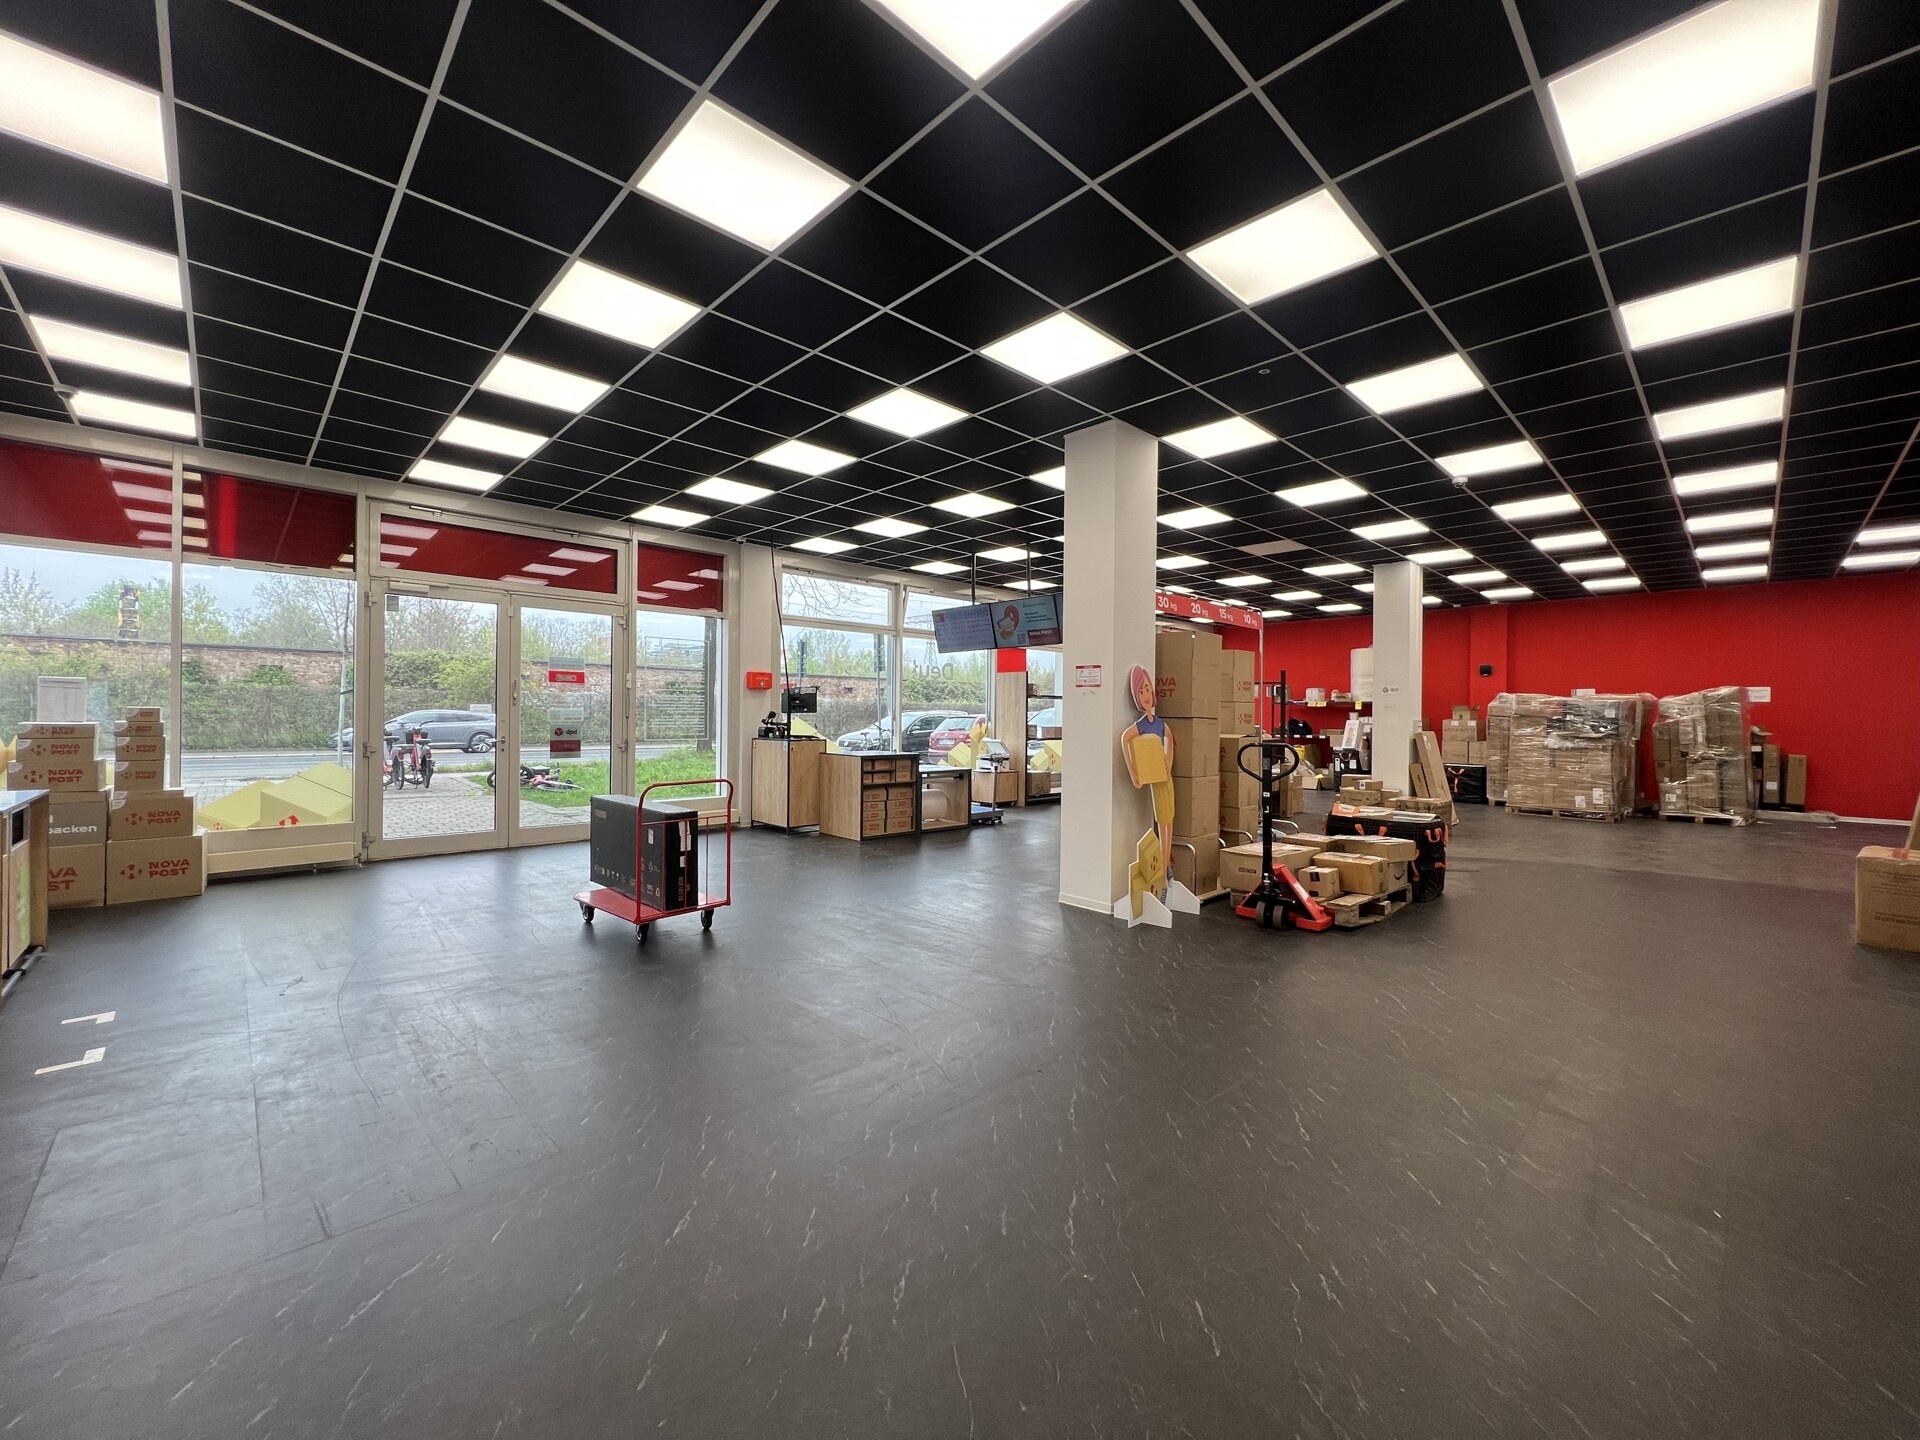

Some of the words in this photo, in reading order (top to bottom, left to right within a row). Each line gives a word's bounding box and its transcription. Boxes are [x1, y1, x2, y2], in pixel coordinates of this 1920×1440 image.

[1157, 595, 1169, 608] 30
[1170, 602, 1178, 611] kg
[1190, 602, 1201, 614] 20
[1201, 608, 1209, 617] kg
[1218, 608, 1227, 619] 15
[1226, 613, 1234, 622] kg
[1243, 613, 1252, 624] 10
[1251, 618, 1258, 627] kg
[565, 728, 578, 736] dpd
[48, 775, 83, 783] POST
[147, 810, 181, 818] NOVA
[148, 859, 190, 869] NOVA
[49, 867, 77, 878] VA
[148, 867, 189, 878] POST
[48, 880, 74, 891] ST
